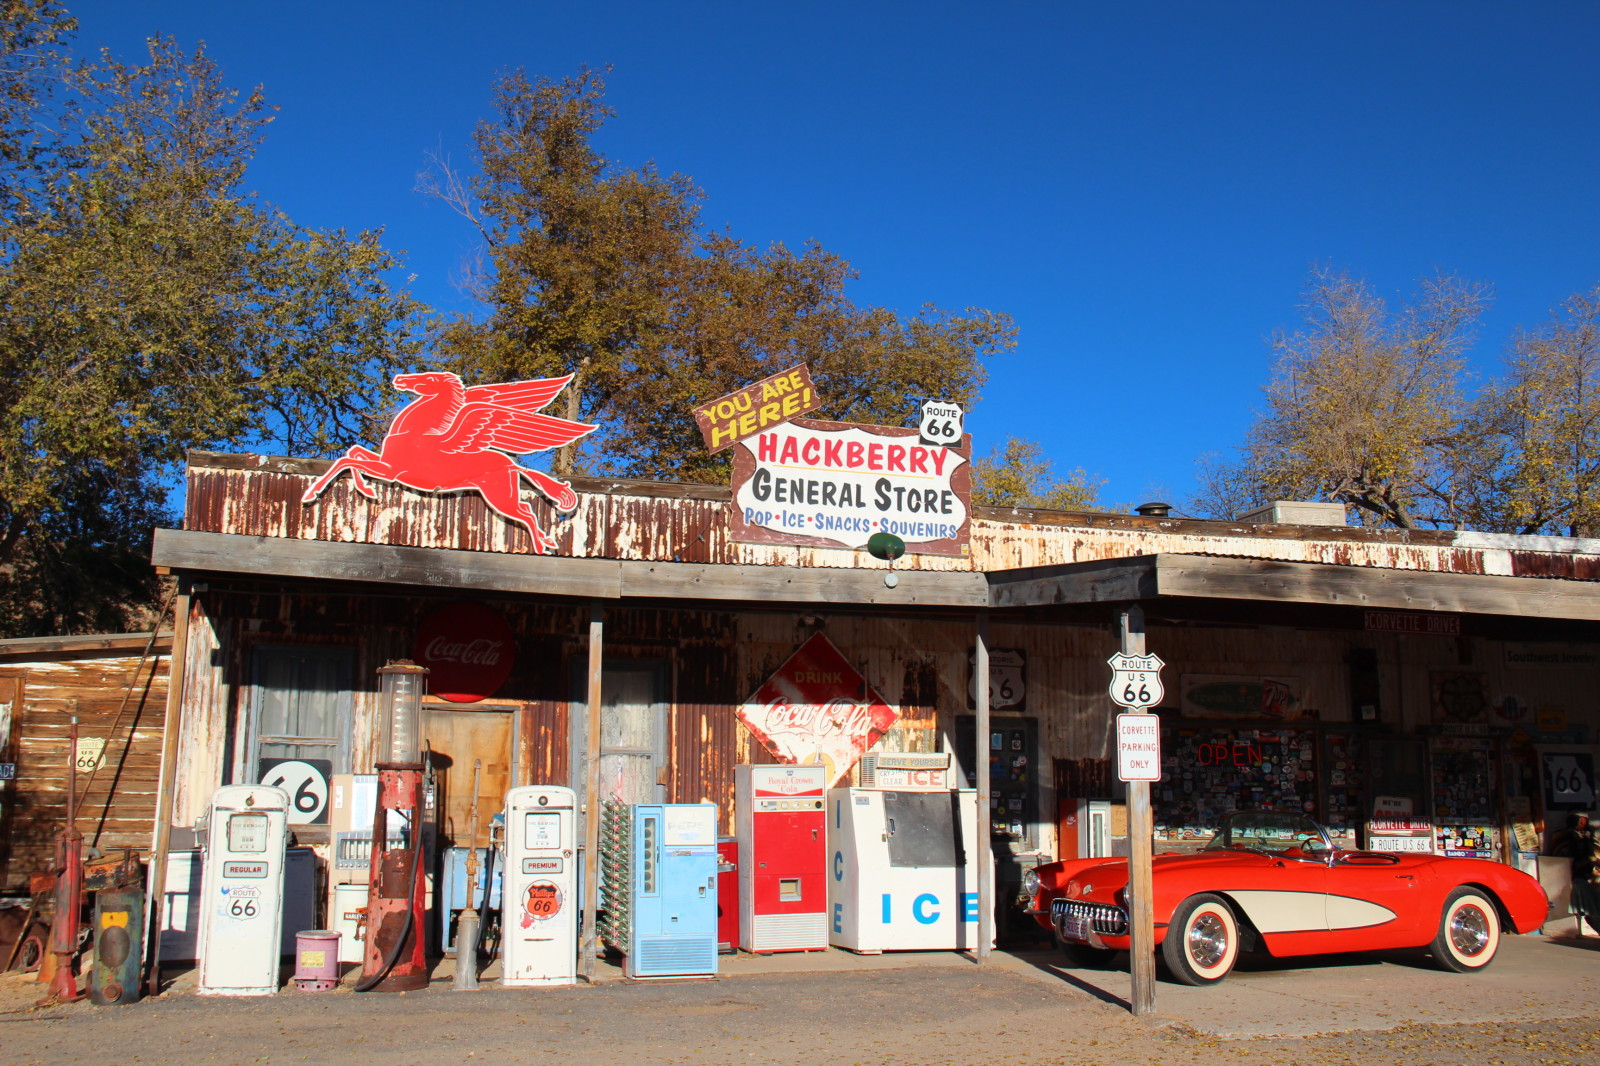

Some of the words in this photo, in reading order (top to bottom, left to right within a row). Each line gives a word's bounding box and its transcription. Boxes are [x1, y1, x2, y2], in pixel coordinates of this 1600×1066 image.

[703, 392, 752, 424] YOU
[762, 371, 804, 402] ARE
[711, 387, 811, 448] HERE!
[926, 407, 957, 418] ROUTE
[926, 419, 955, 438] 66
[758, 433, 948, 476] HACKBERRY
[752, 467, 866, 508] GENERAL
[875, 477, 953, 514] STORE
[744, 507, 772, 526] POP
[783, 510, 805, 528] ICE
[815, 512, 870, 533] SNACKS
[880, 517, 957, 539] SOUVENIRS
[1369, 613, 1420, 631] CORVETTE
[1427, 616, 1456, 633] DRIVE
[425, 635, 504, 666] Coca-Cola
[1507, 651, 1559, 663] Southwest
[1122, 660, 1152, 669] ROUTE
[795, 672, 843, 683] DRINK
[1124, 683, 1151, 702] 66
[765, 696, 875, 736] Coca-Cola
[1122, 726, 1155, 734] CORVETTE
[1122, 743, 1156, 751] PARKING
[1197, 744, 1262, 766] OPEN
[77, 756, 96, 767] 66
[881, 758, 907, 766] SERVE
[910, 759, 948, 767] YOURSELF
[1130, 760, 1149, 768] ONLY
[768, 777, 789, 785] Royal
[907, 770, 942, 785] ICE
[1556, 768, 1581, 792] 66
[1379, 840, 1399, 850] ROUTE
[1417, 840, 1425, 850] 66
[530, 888, 555, 898] Phillips
[231, 899, 256, 916] 66
[533, 900, 552, 912] 66
[882, 892, 978, 925] ICE
